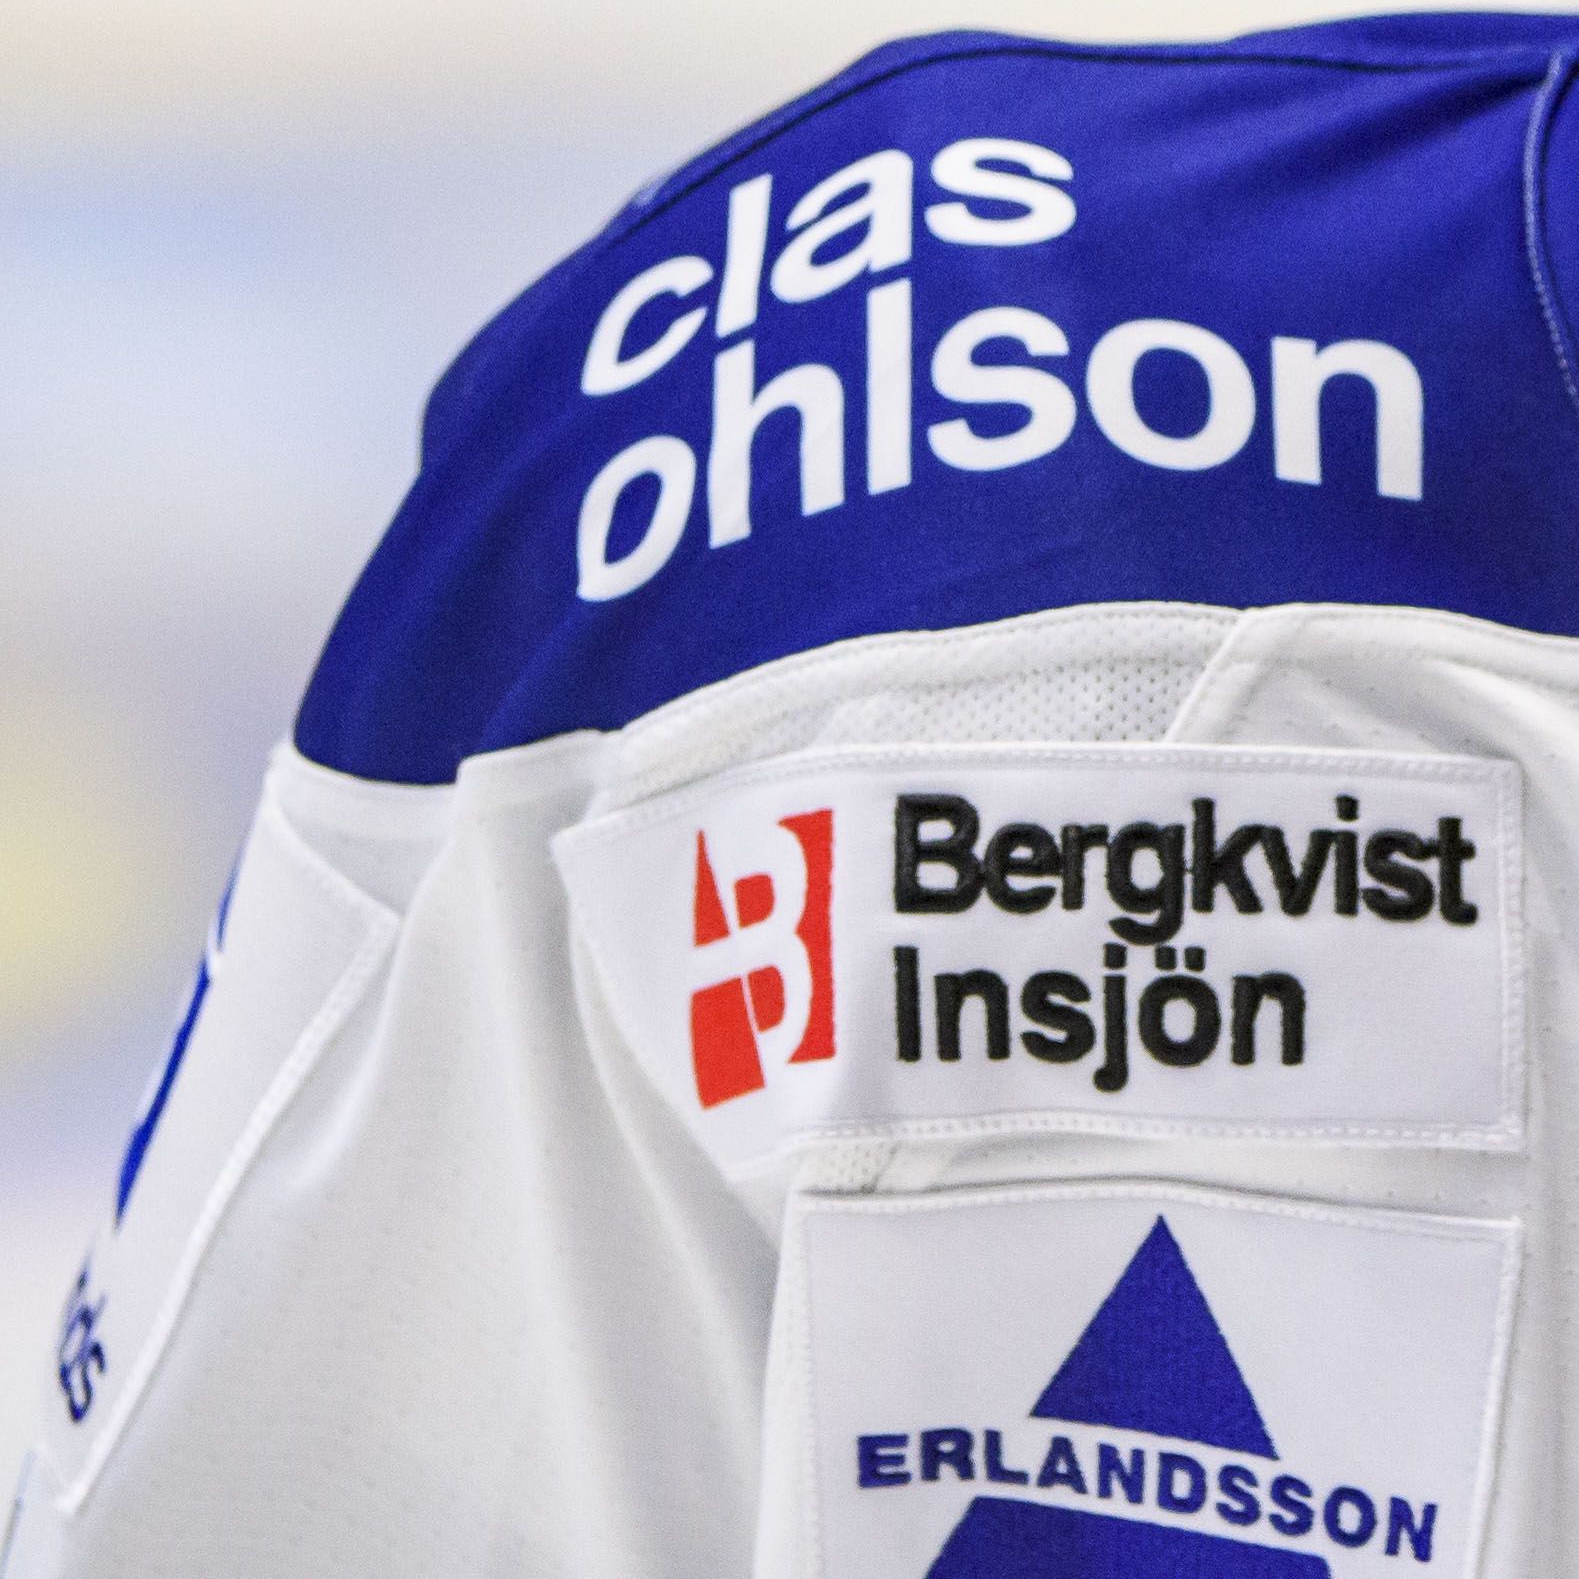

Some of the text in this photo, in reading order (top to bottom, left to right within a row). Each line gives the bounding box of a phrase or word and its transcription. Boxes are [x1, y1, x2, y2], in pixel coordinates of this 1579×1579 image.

[580, 137, 1078, 397] clas
[576, 277, 1425, 602] ohlson
[892, 793, 1479, 946] Bergkvist
[892, 943, 1308, 1093] Insjön
[856, 1426, 1438, 1564] ERLANDSSON
